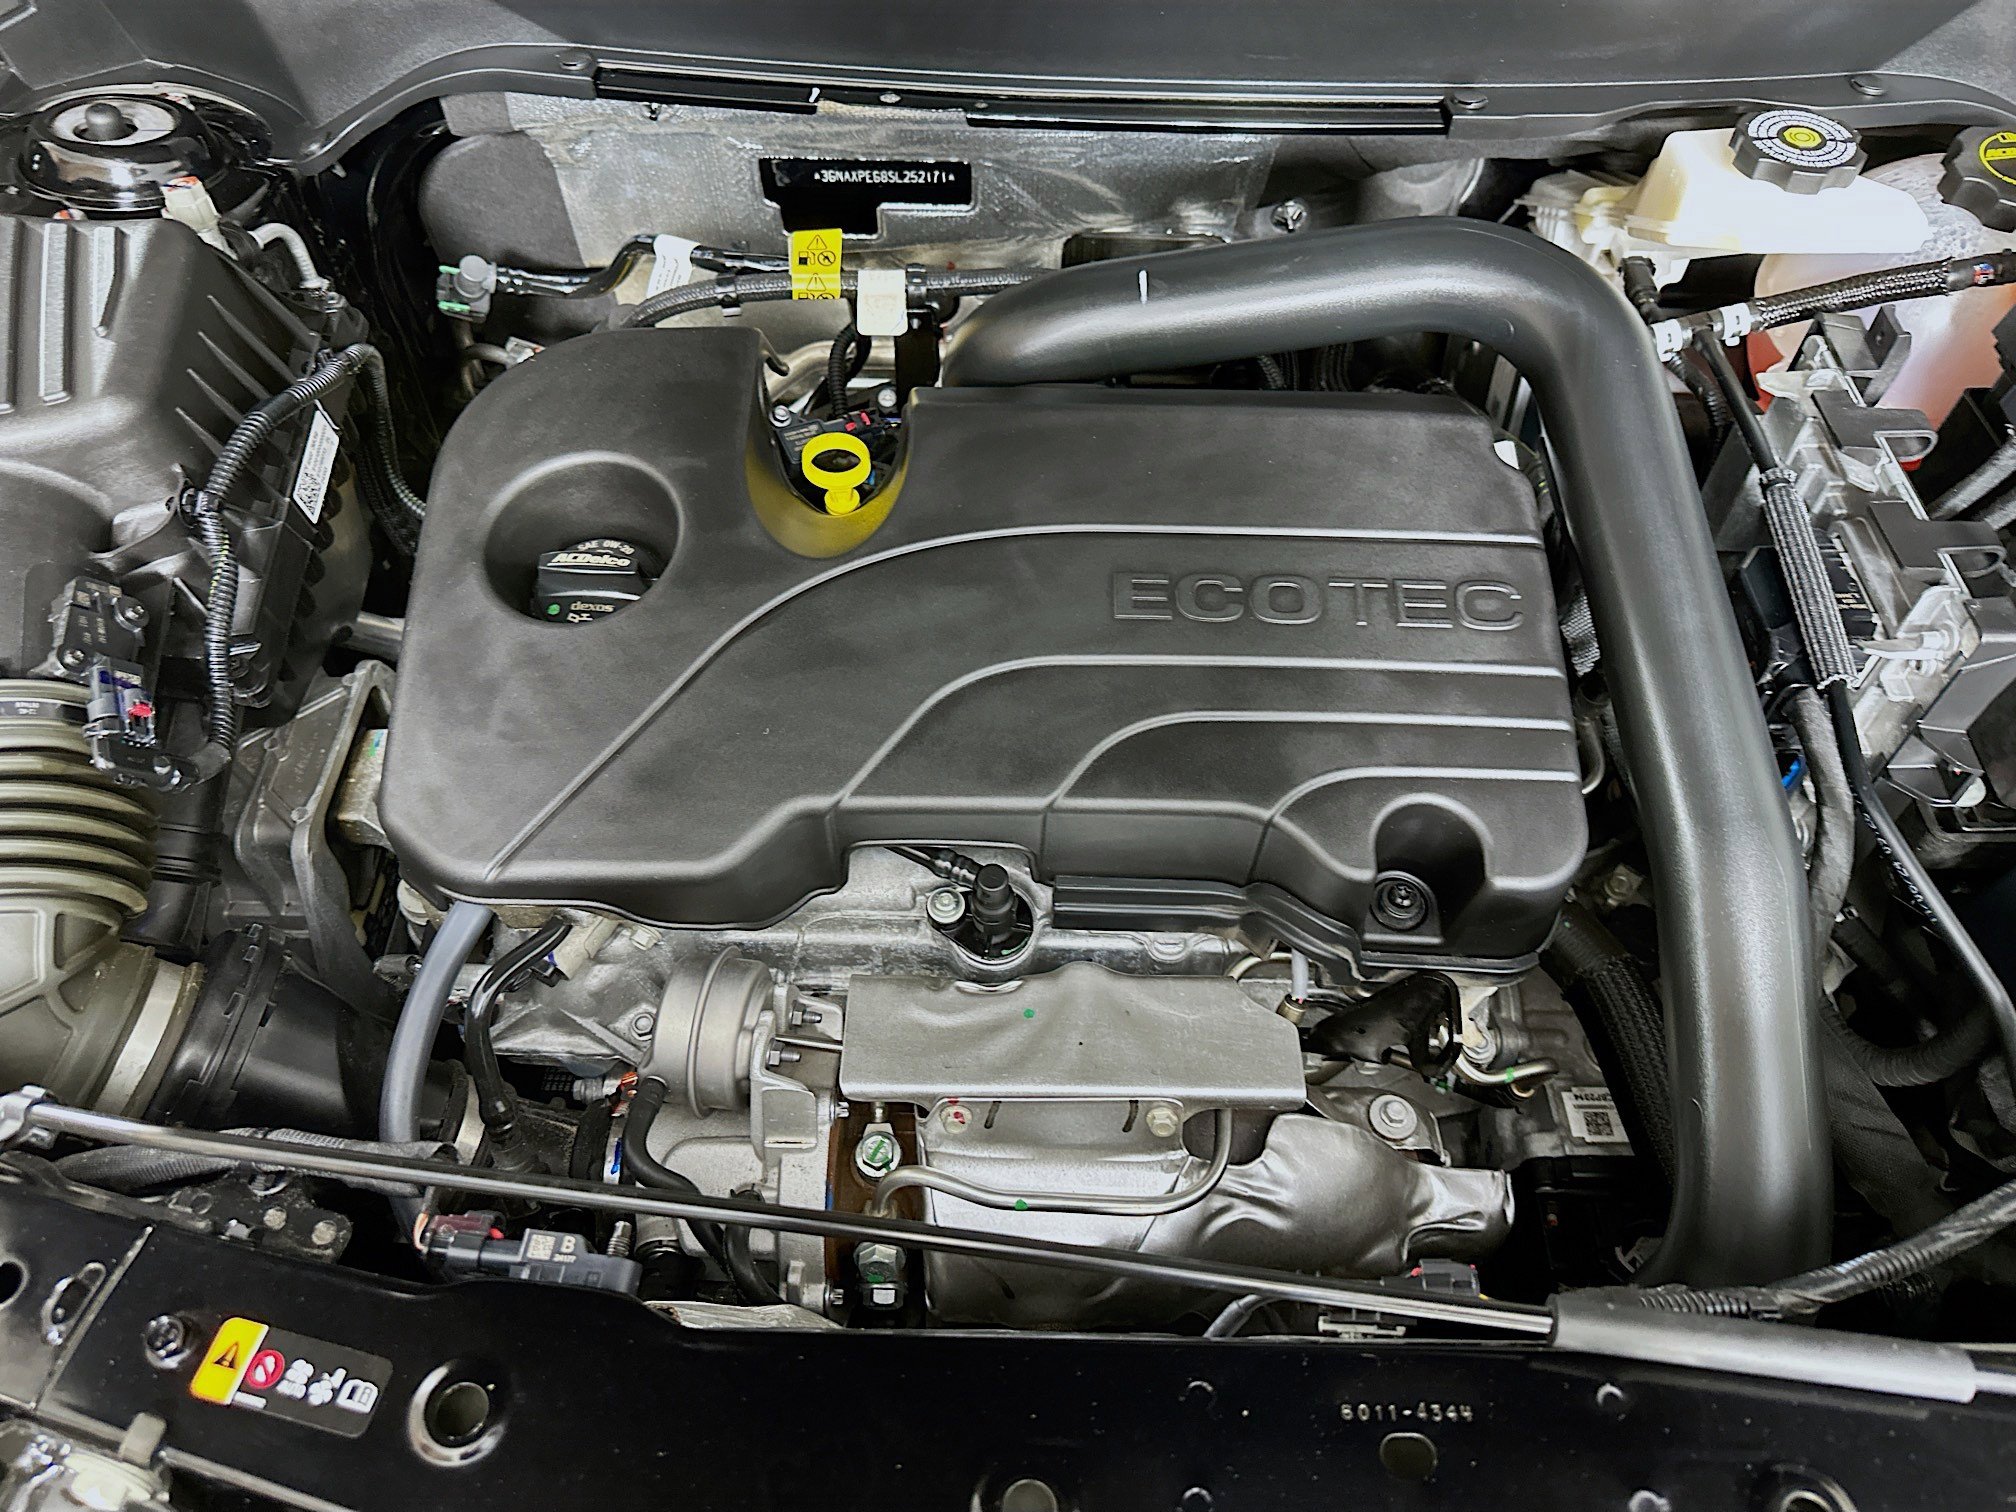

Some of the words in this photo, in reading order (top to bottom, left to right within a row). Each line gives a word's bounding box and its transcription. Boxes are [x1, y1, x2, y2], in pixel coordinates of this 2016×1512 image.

[577, 541, 600, 551] SAE
[550, 552, 631, 567] ACDelco
[570, 601, 616, 612] dexos
[1112, 571, 1525, 632] ECOTEC
[560, 1235, 576, 1253] B
